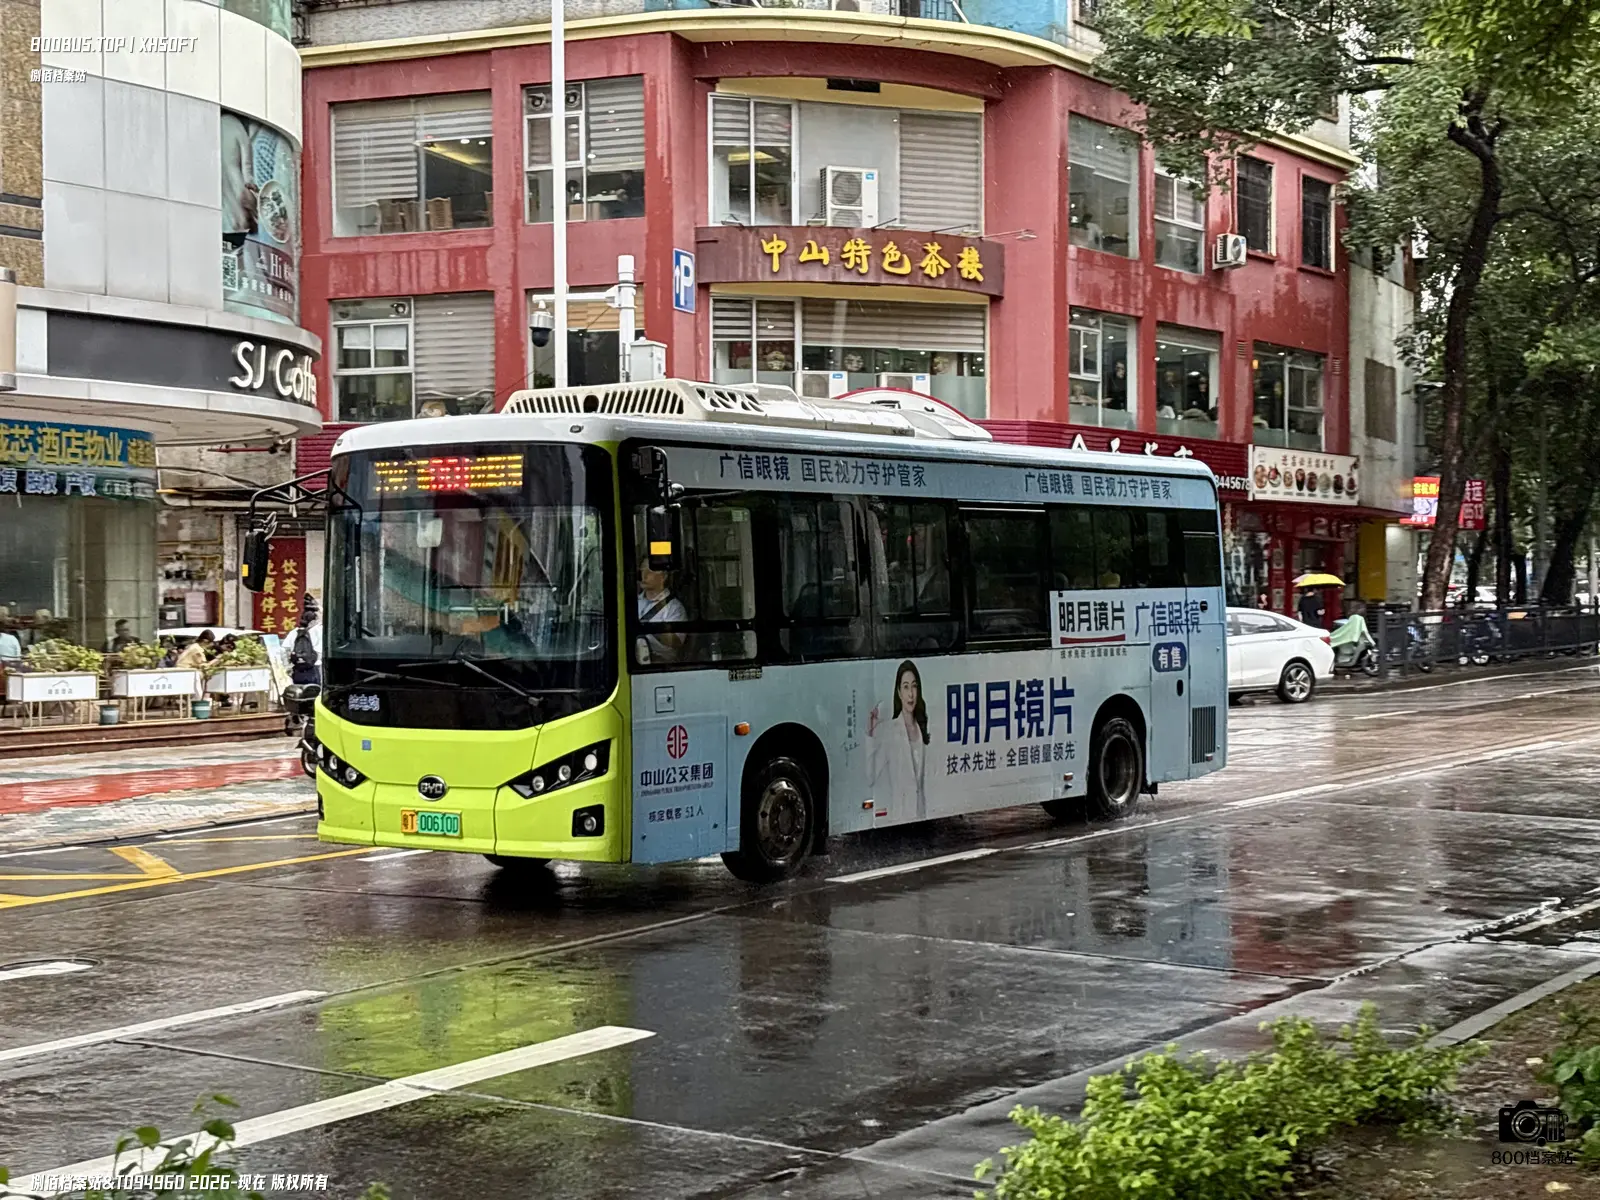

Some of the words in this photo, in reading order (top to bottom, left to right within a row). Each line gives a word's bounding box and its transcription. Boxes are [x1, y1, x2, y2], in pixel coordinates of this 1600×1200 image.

[680, 254, 694, 306] P
[228, 341, 267, 389] SJ
[719, 453, 790, 483] 广信眼镜
[801, 457, 927, 488] 国民视力守护管家
[1024, 471, 1075, 496] 广信眼镜
[1081, 474, 1172, 500] 国民视力守护管家
[1058, 600, 1125, 633] 明月镜片
[1135, 599, 1201, 637] 广信眼镜
[1157, 646, 1182, 669] 有售
[946, 676, 1075, 745] 明月镜片
[420, 782, 443, 794] BYD
[640, 762, 714, 787] 中山公交集团
